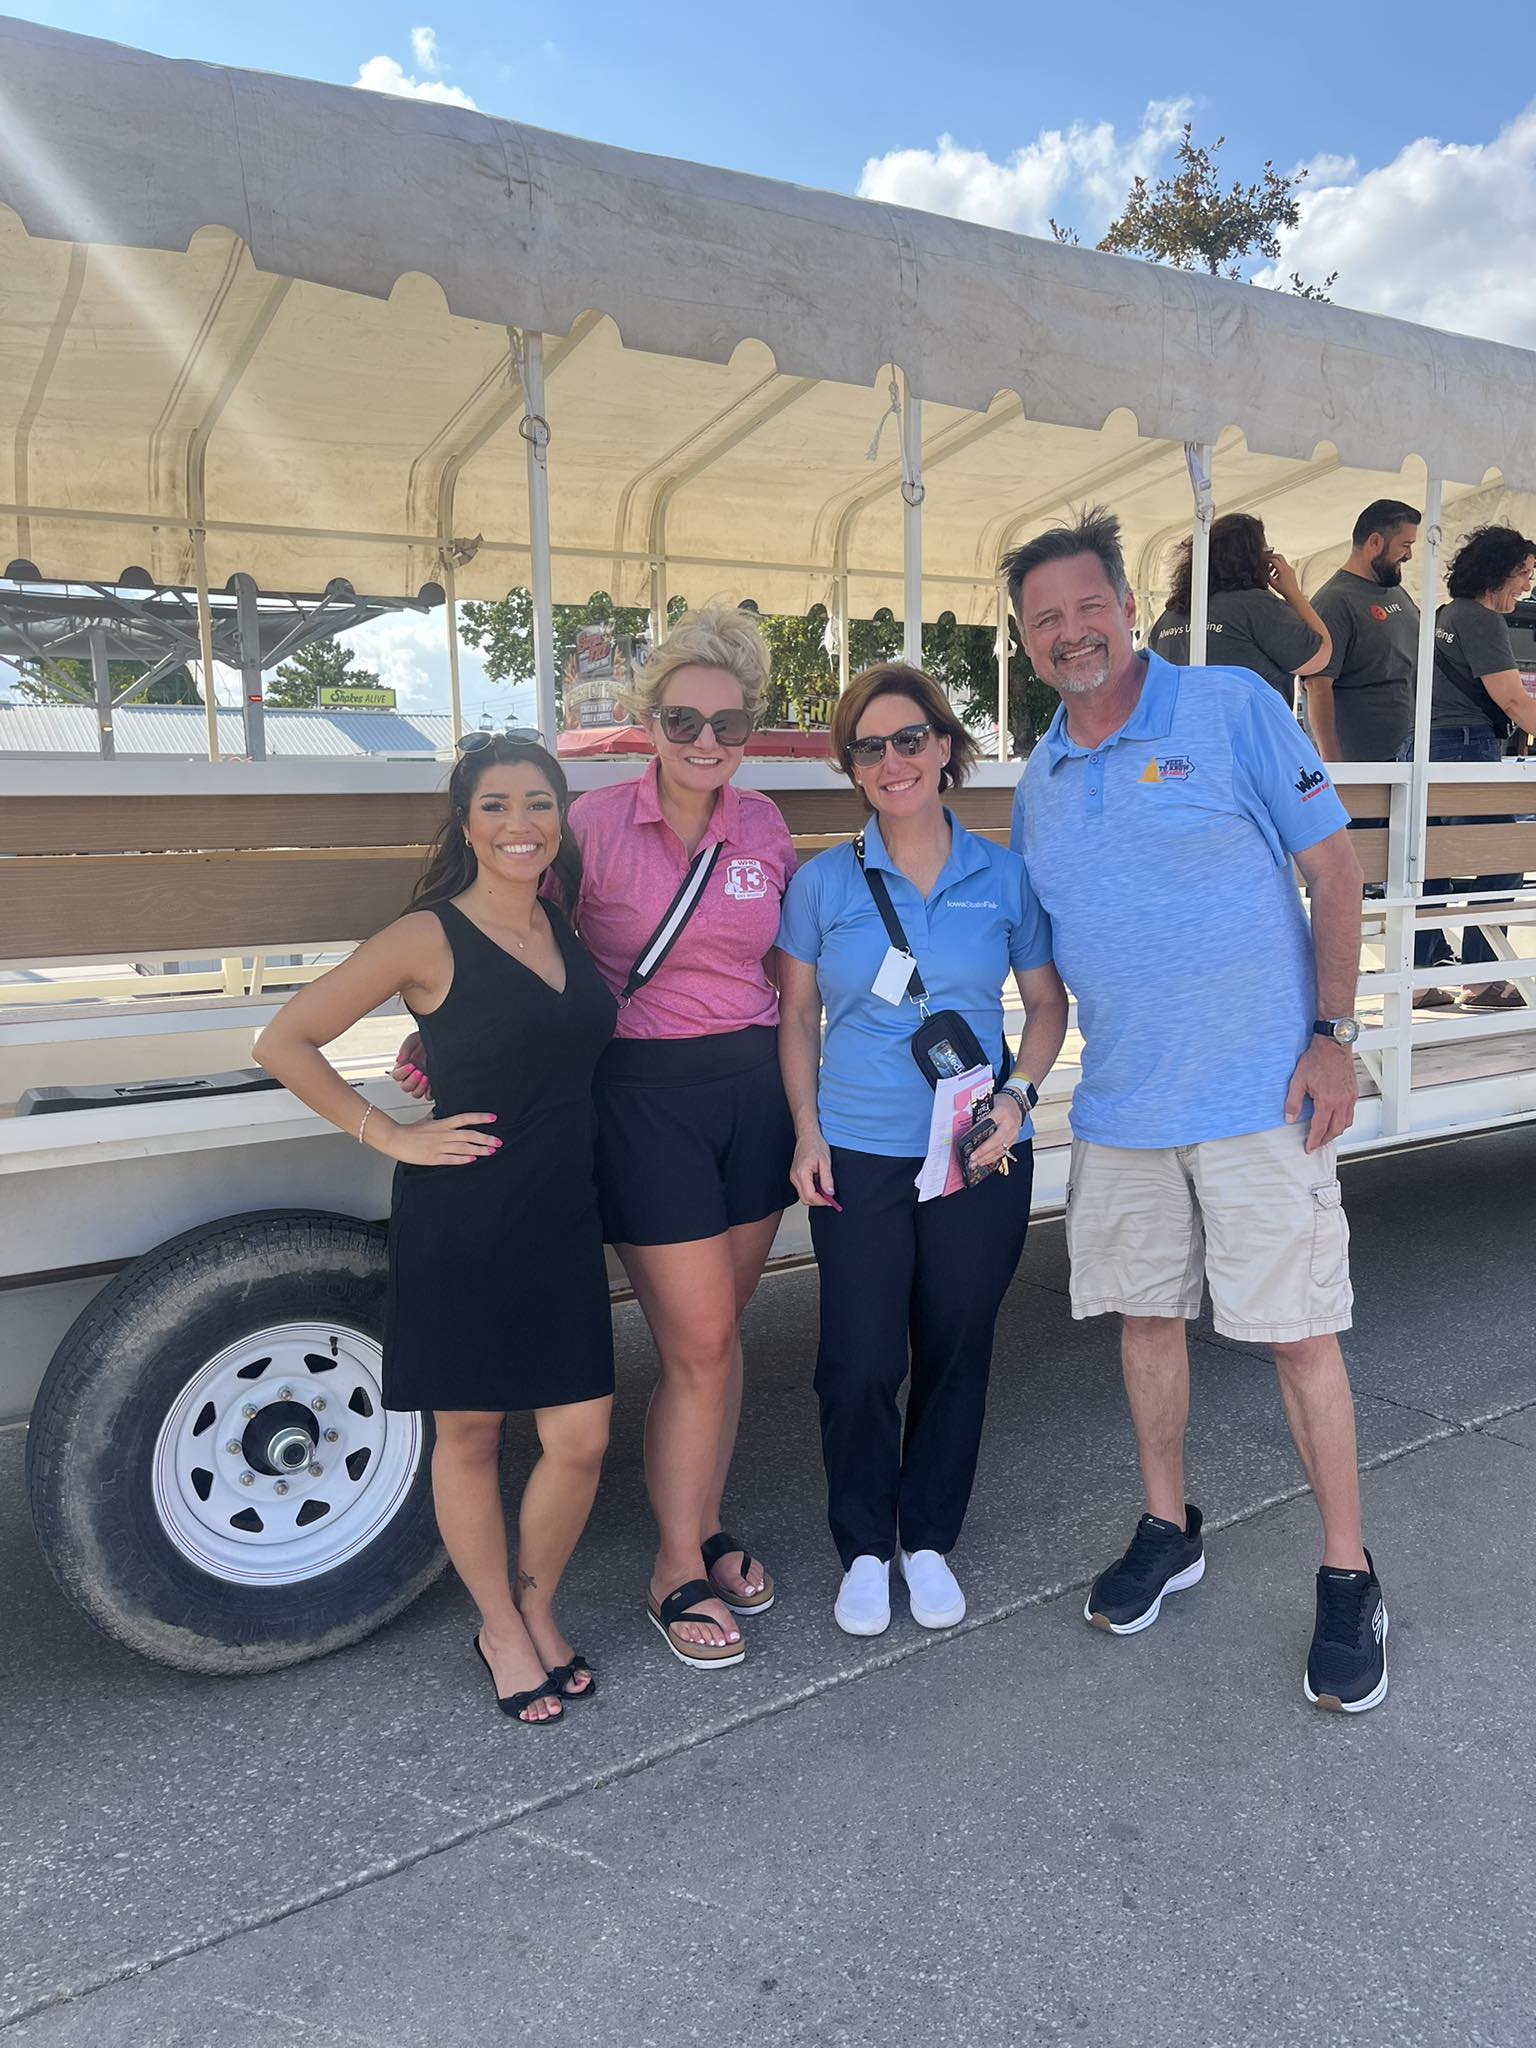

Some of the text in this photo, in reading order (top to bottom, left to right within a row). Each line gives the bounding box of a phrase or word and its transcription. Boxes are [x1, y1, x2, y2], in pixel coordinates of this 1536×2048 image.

[1384, 603, 1402, 614] LIFE
[1159, 626, 1184, 640] Always
[364, 694, 386, 704] ALIVE
[1294, 770, 1325, 794] WHO
[735, 866, 765, 891] 13
